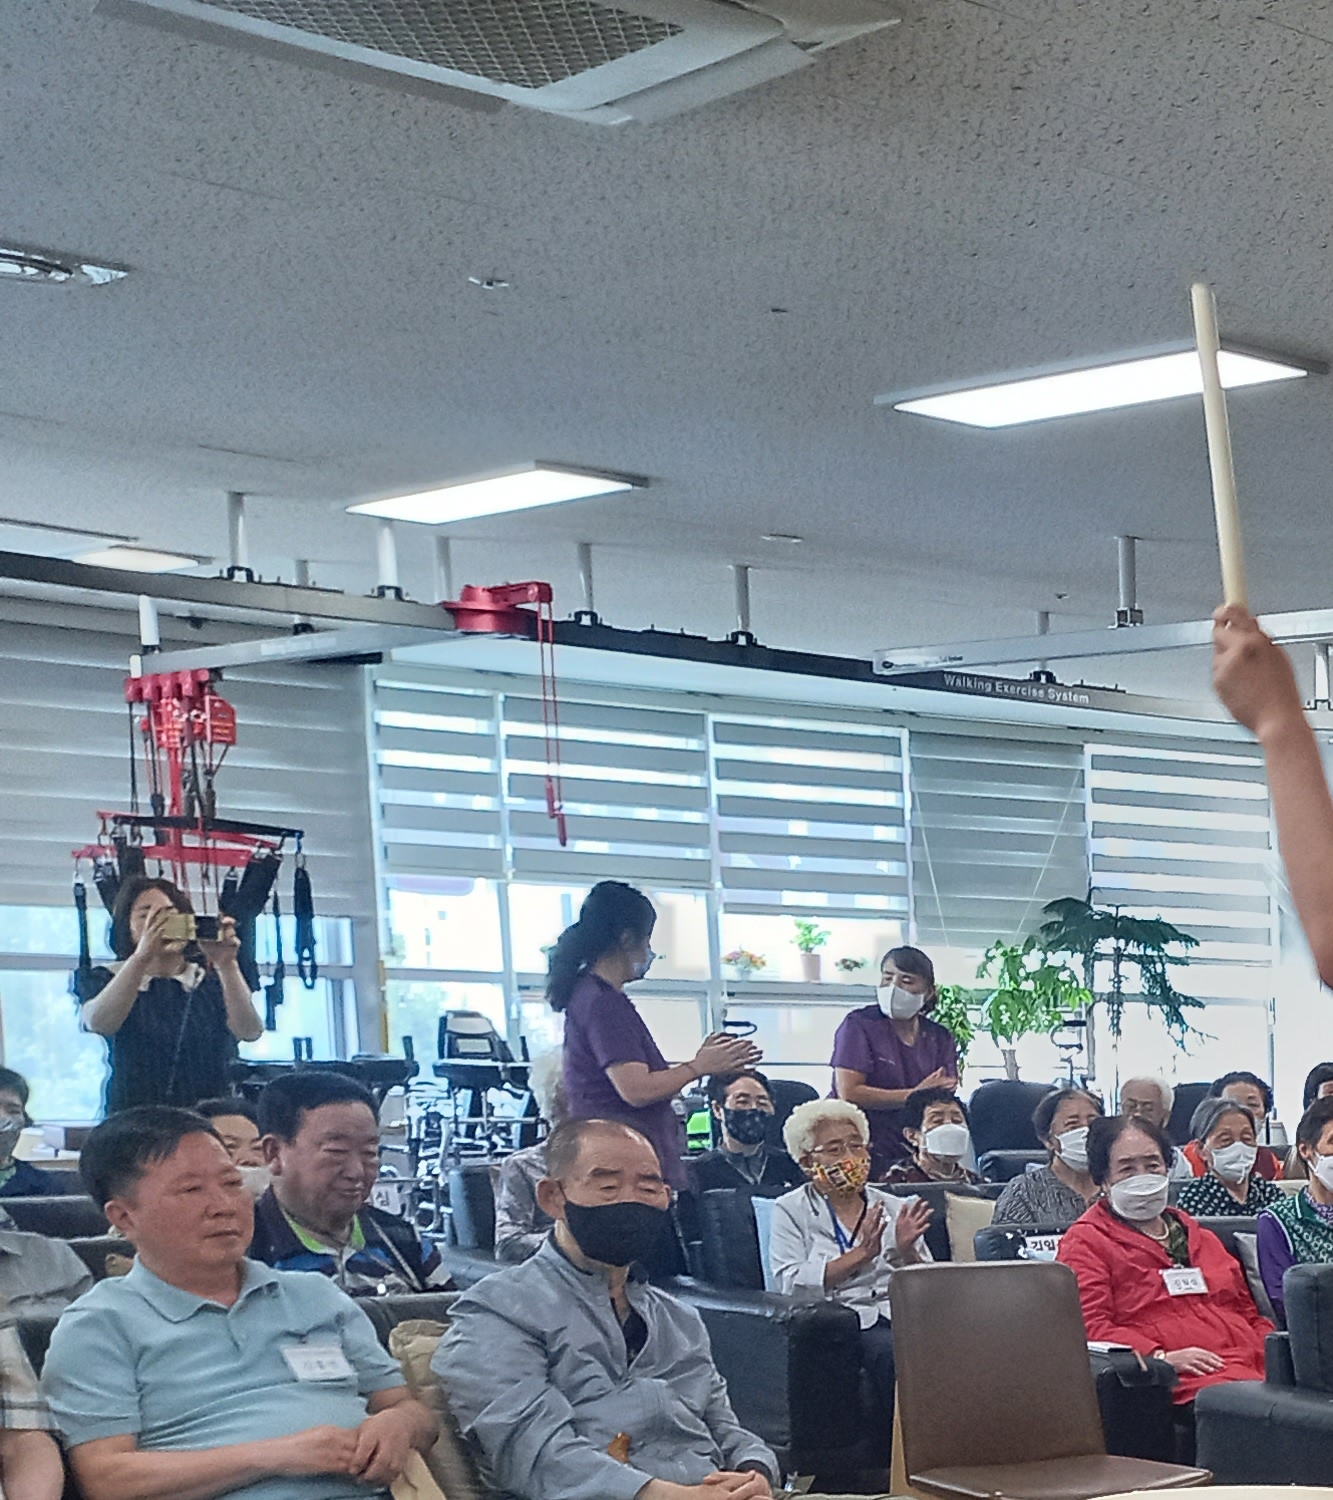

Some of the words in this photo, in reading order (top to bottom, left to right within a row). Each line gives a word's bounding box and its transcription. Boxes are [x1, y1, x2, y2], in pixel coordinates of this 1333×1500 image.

[944, 674, 992, 693] Walking
[995, 681, 1045, 698] Exercise
[1047, 688, 1090, 704] System
